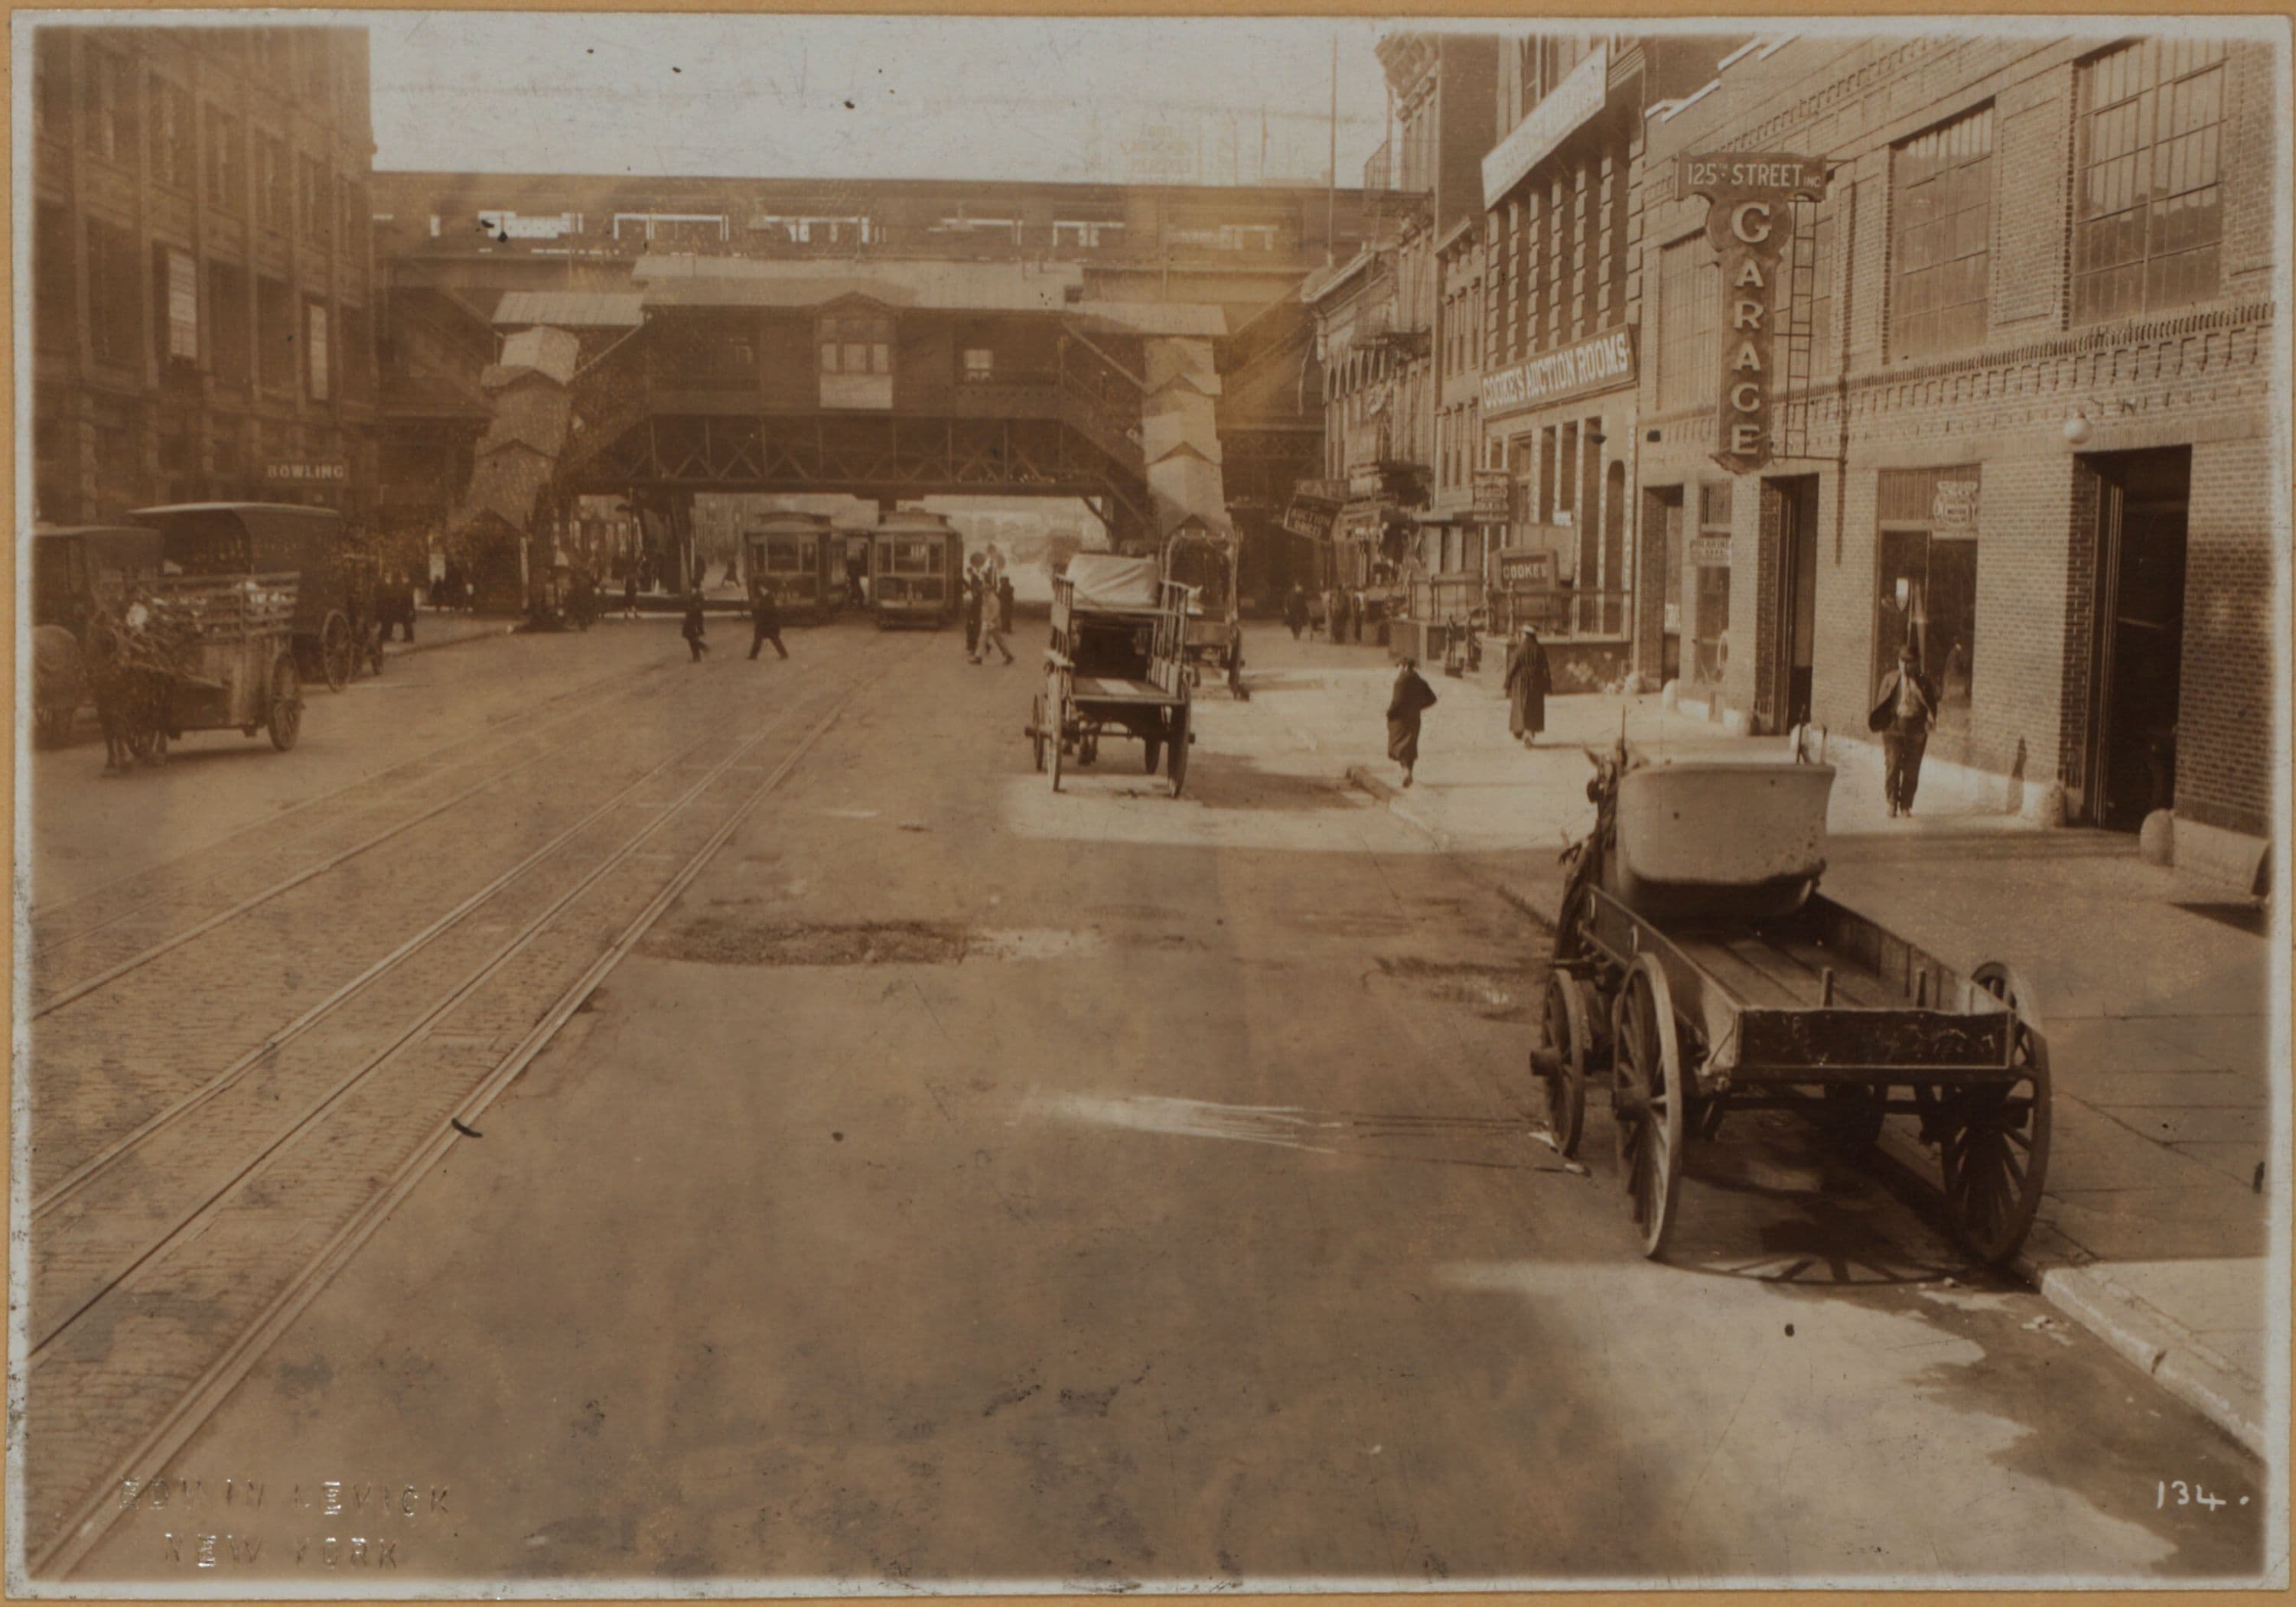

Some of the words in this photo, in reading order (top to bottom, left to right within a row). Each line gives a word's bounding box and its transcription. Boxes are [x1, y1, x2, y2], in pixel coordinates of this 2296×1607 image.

[1731, 161, 1804, 188] STREET
[1731, 202, 1772, 455] GARAGE
[1525, 347, 1577, 400] AUCTION
[1576, 331, 1629, 385] ROOMS
[266, 464, 345, 479] BOWLING
